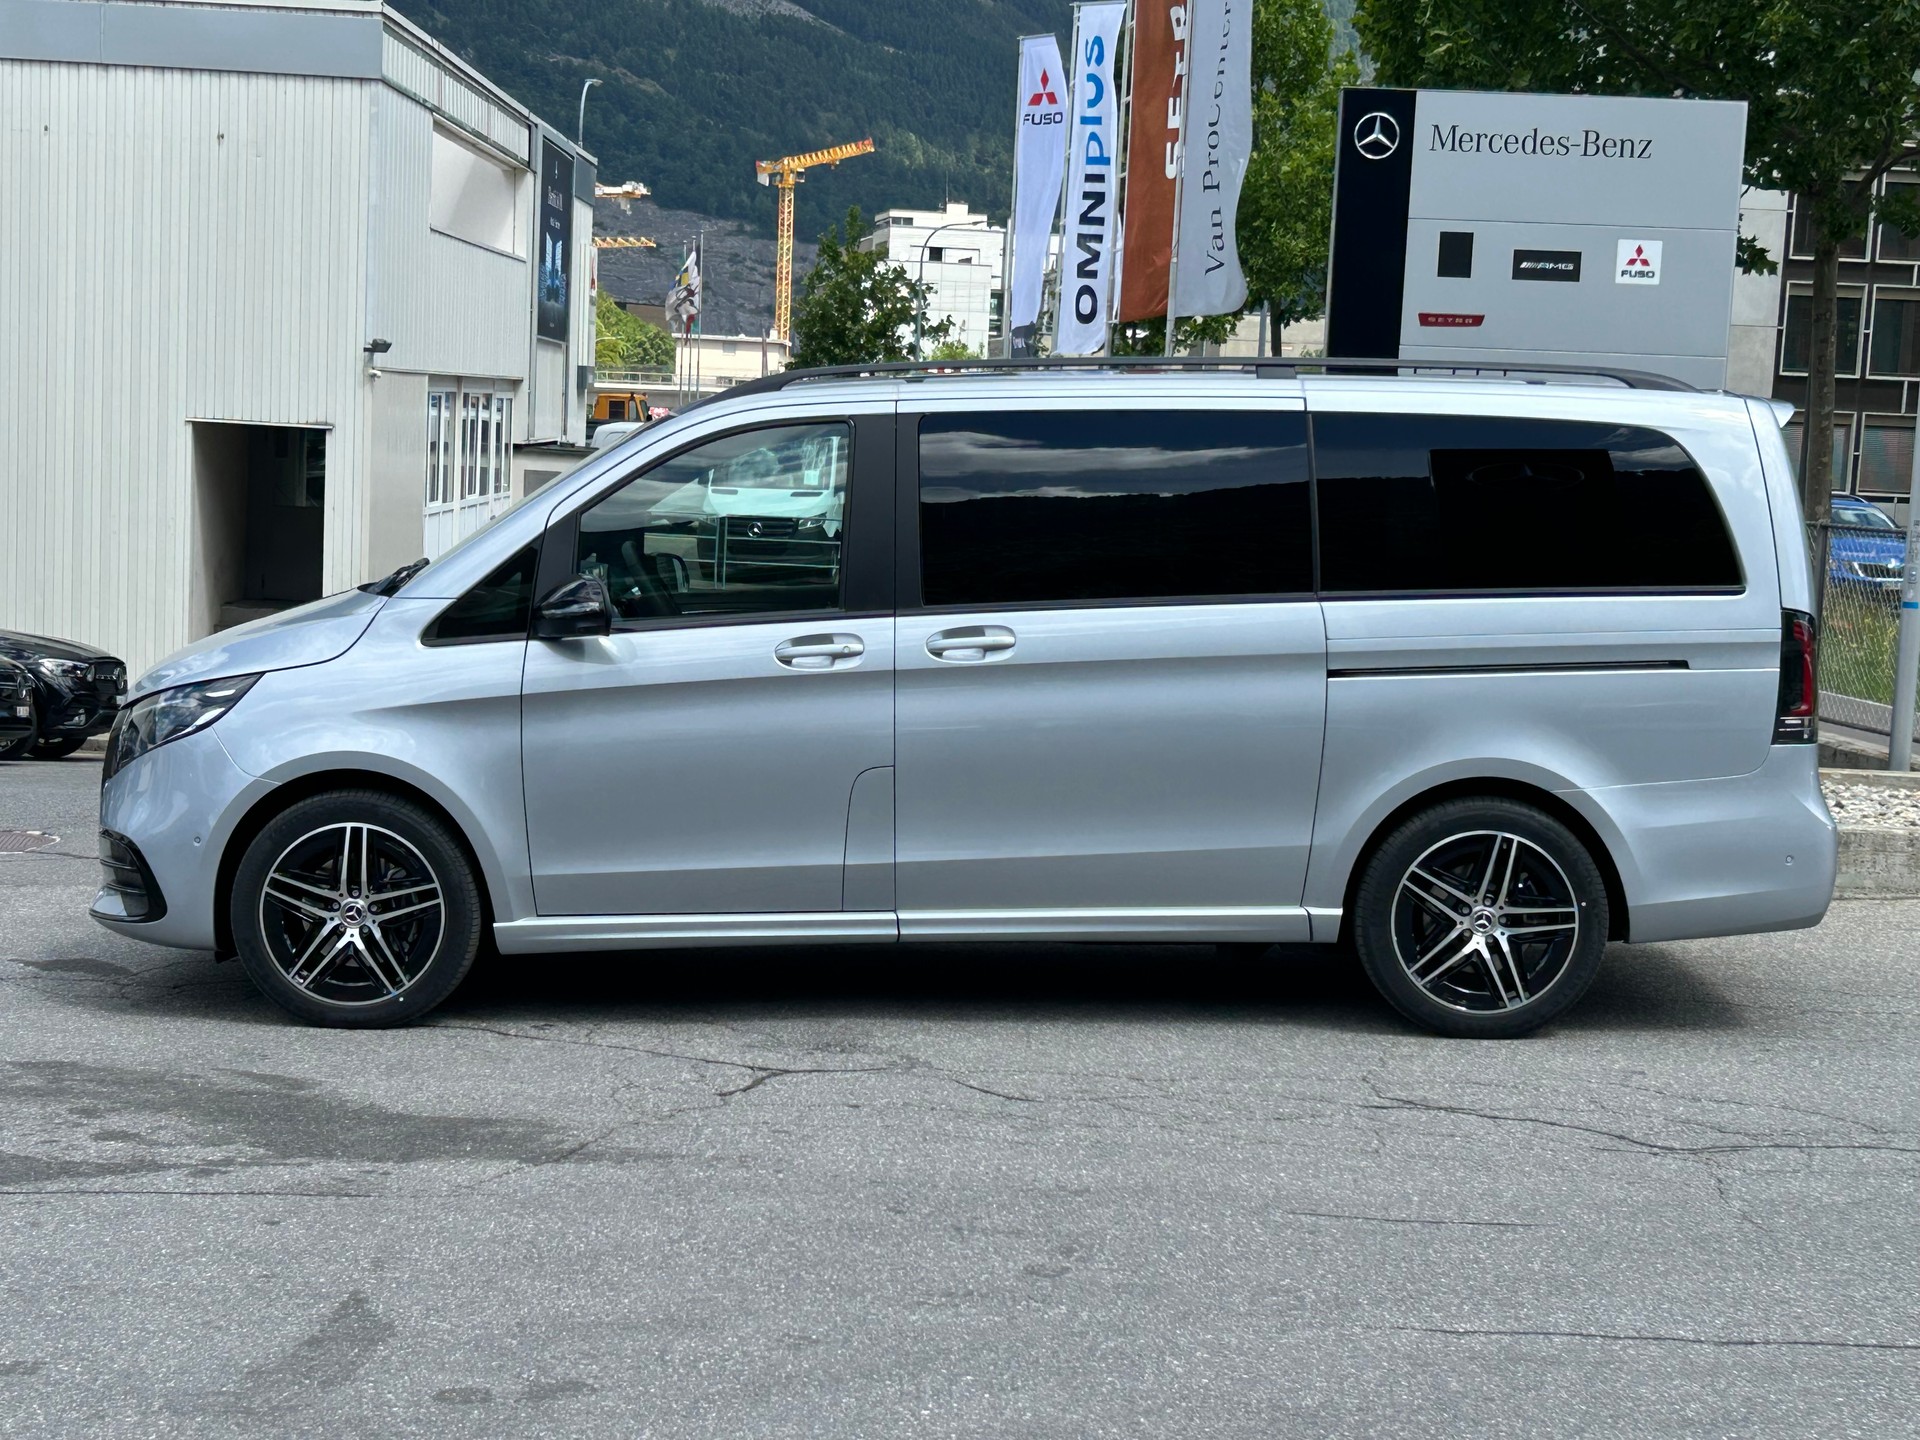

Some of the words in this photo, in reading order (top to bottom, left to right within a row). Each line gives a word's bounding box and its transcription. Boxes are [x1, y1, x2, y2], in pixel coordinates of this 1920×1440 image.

[1022, 111, 1064, 126] FUSO
[1429, 124, 1653, 159] Mercedes-Benz
[1075, 35, 1111, 325] OMNIplus
[1204, 207, 1225, 276] Van
[1620, 269, 1656, 279] FUSO
